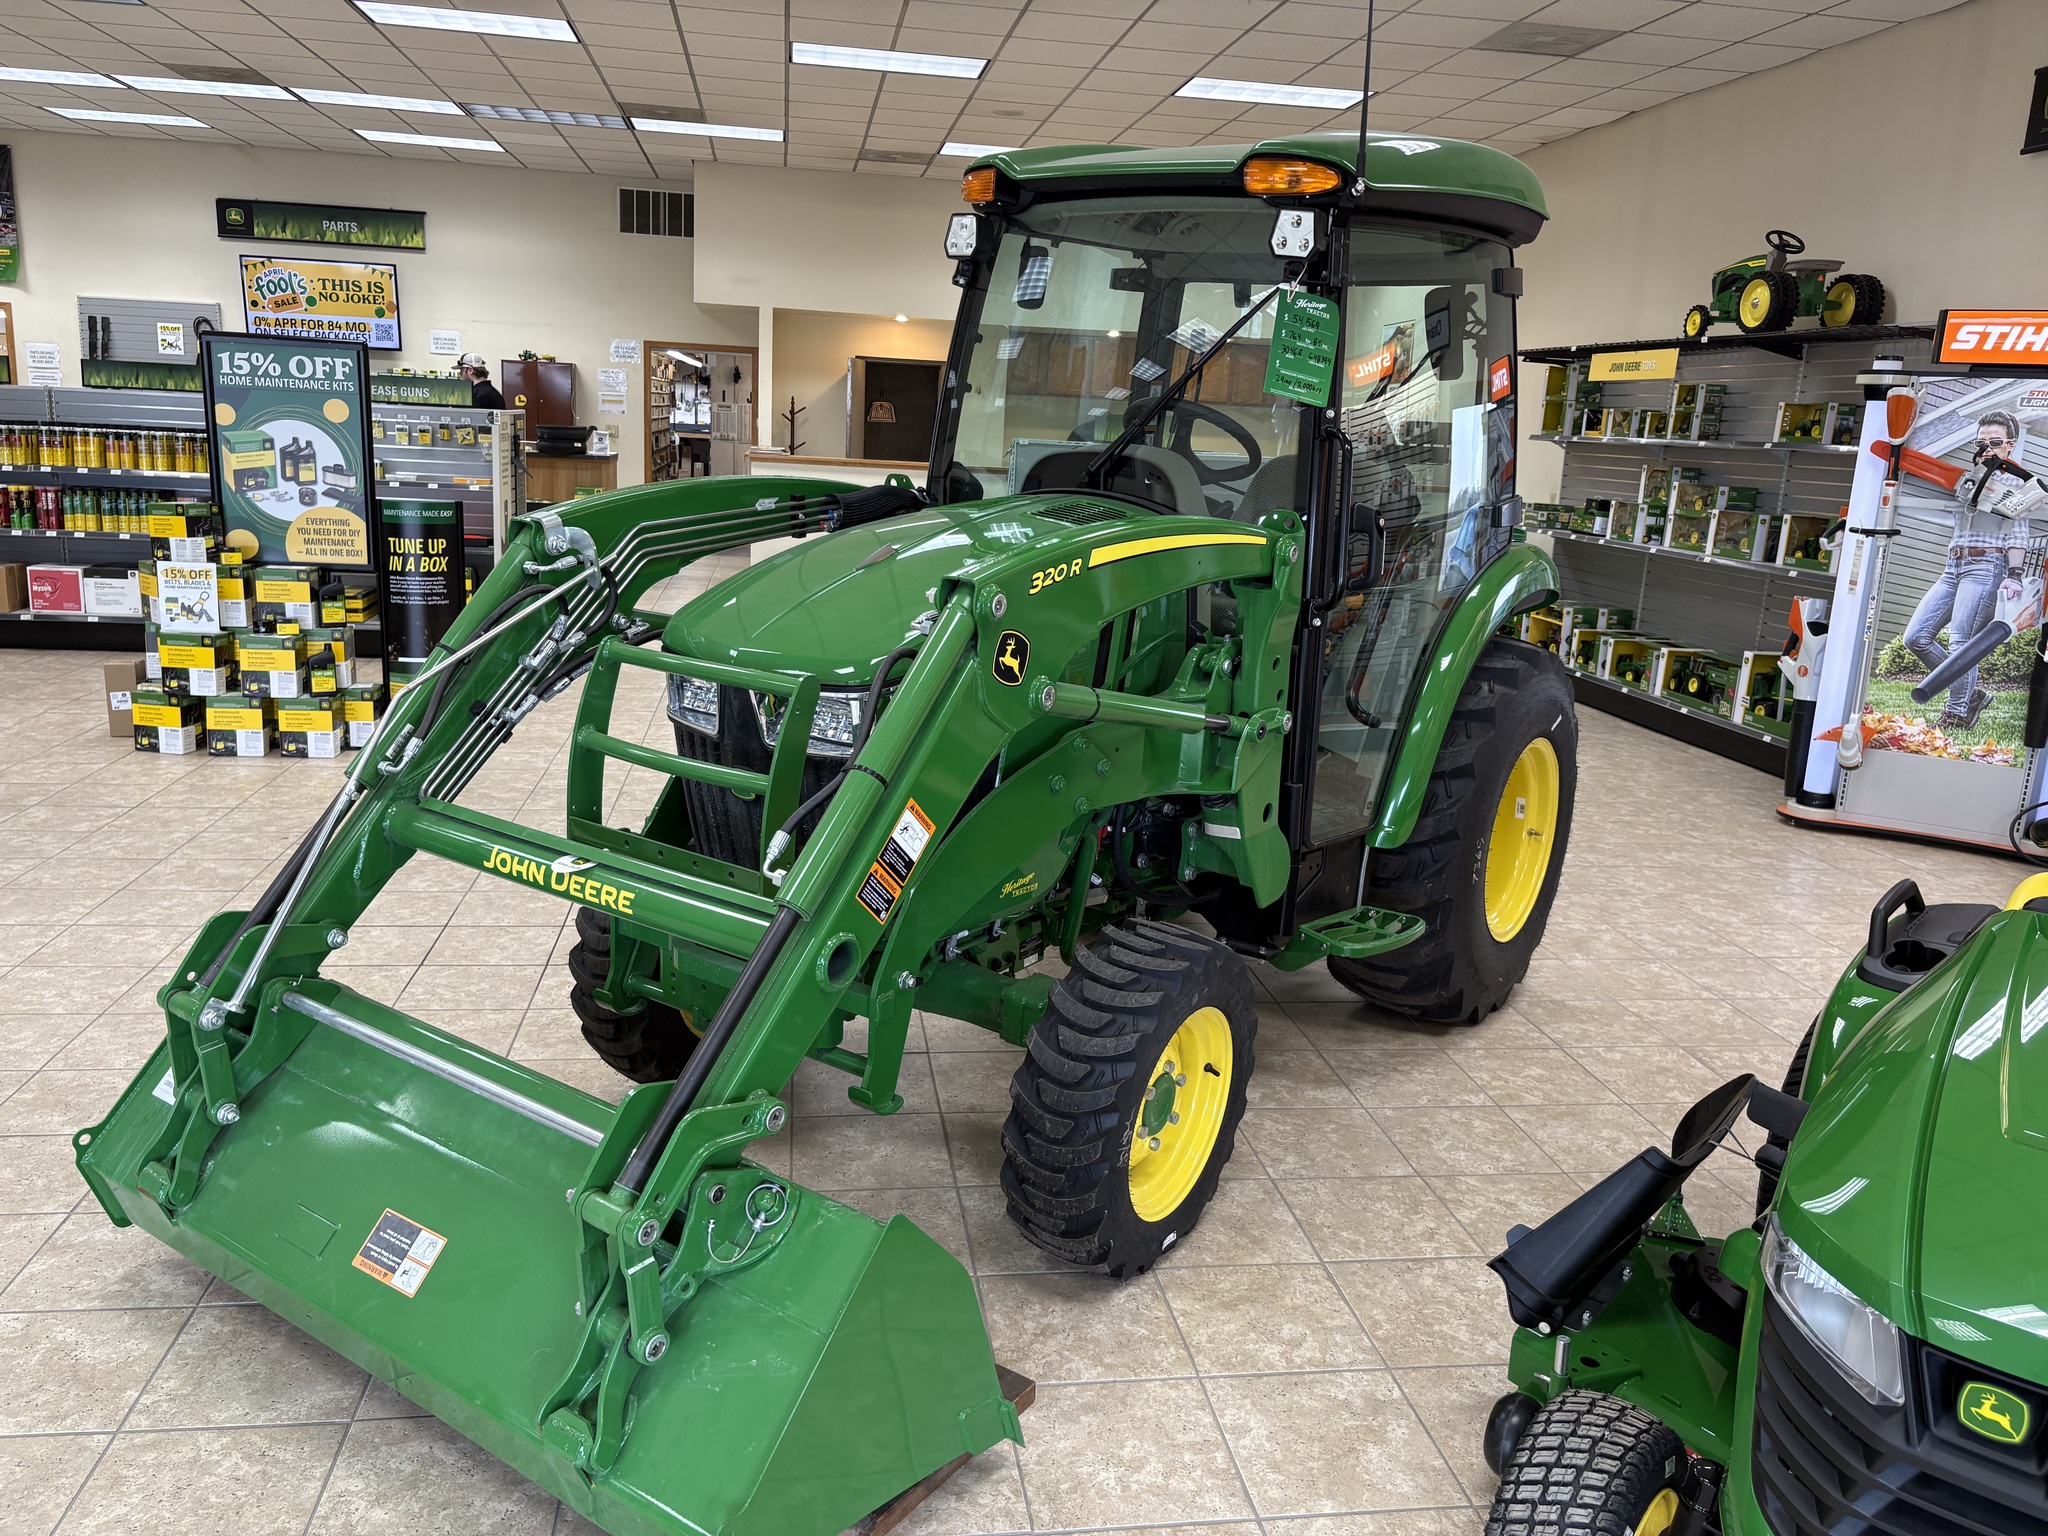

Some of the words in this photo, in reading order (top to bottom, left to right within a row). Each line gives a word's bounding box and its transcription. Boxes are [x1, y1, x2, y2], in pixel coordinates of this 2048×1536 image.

[323, 221, 358, 232] PARTS
[263, 269, 285, 278] APRIL
[254, 271, 308, 300] fool's
[318, 278, 363, 292] THIS
[368, 281, 384, 294] IS
[274, 296, 299, 308] SALE
[319, 292, 339, 303] NO
[343, 294, 386, 305] JOKE!
[1295, 299, 1327, 309] Heritage
[1306, 308, 1330, 319] TRACTOR
[254, 316, 271, 328] 0%
[274, 318, 297, 329] APR
[301, 319, 324, 330] FOR
[328, 321, 342, 331] 84
[346, 321, 371, 333] MO.
[1292, 315, 1320, 331] 54,569
[1289, 331, 1302, 341] 764
[1950, 325, 2048, 352] STIH
[217, 352, 281, 376] 15%
[289, 356, 353, 380] OFF
[1609, 362, 1624, 373] JOHN
[1625, 362, 1641, 371] DEERE
[1642, 361, 1656, 370] TOYS
[220, 375, 253, 386] HOME
[255, 377, 330, 390] MAINTENANCE
[333, 381, 354, 391] KITS
[371, 385, 397, 396] EASE
[401, 387, 430, 397] GUNS
[384, 509, 421, 517] MAINTENANCE
[306, 518, 350, 527] EVERYTHING
[297, 528, 311, 536] YOU
[313, 528, 331, 536] NEED
[333, 529, 347, 537] FOR
[304, 538, 355, 547] MAINTENANCE
[388, 537, 424, 554] TUNE
[428, 539, 447, 554] UP
[305, 548, 318, 556] ALL
[320, 548, 327, 556] IN
[329, 549, 344, 557] ONE
[346, 549, 363, 557] BOX!
[389, 556, 403, 571] IN
[406, 557, 415, 572] A
[420, 557, 449, 572] BOX
[165, 569, 186, 579] 15%
[190, 570, 211, 580] OFF
[1029, 565, 1067, 595] 320
[1070, 558, 1083, 578] R
[915, 808, 932, 831] WARNING
[483, 846, 546, 886] JOHN
[551, 872, 636, 915] DEERE
[879, 873, 897, 895] WARNING
[1000, 872, 1035, 898] Heritage
[358, 1259, 383, 1276] WARNING
